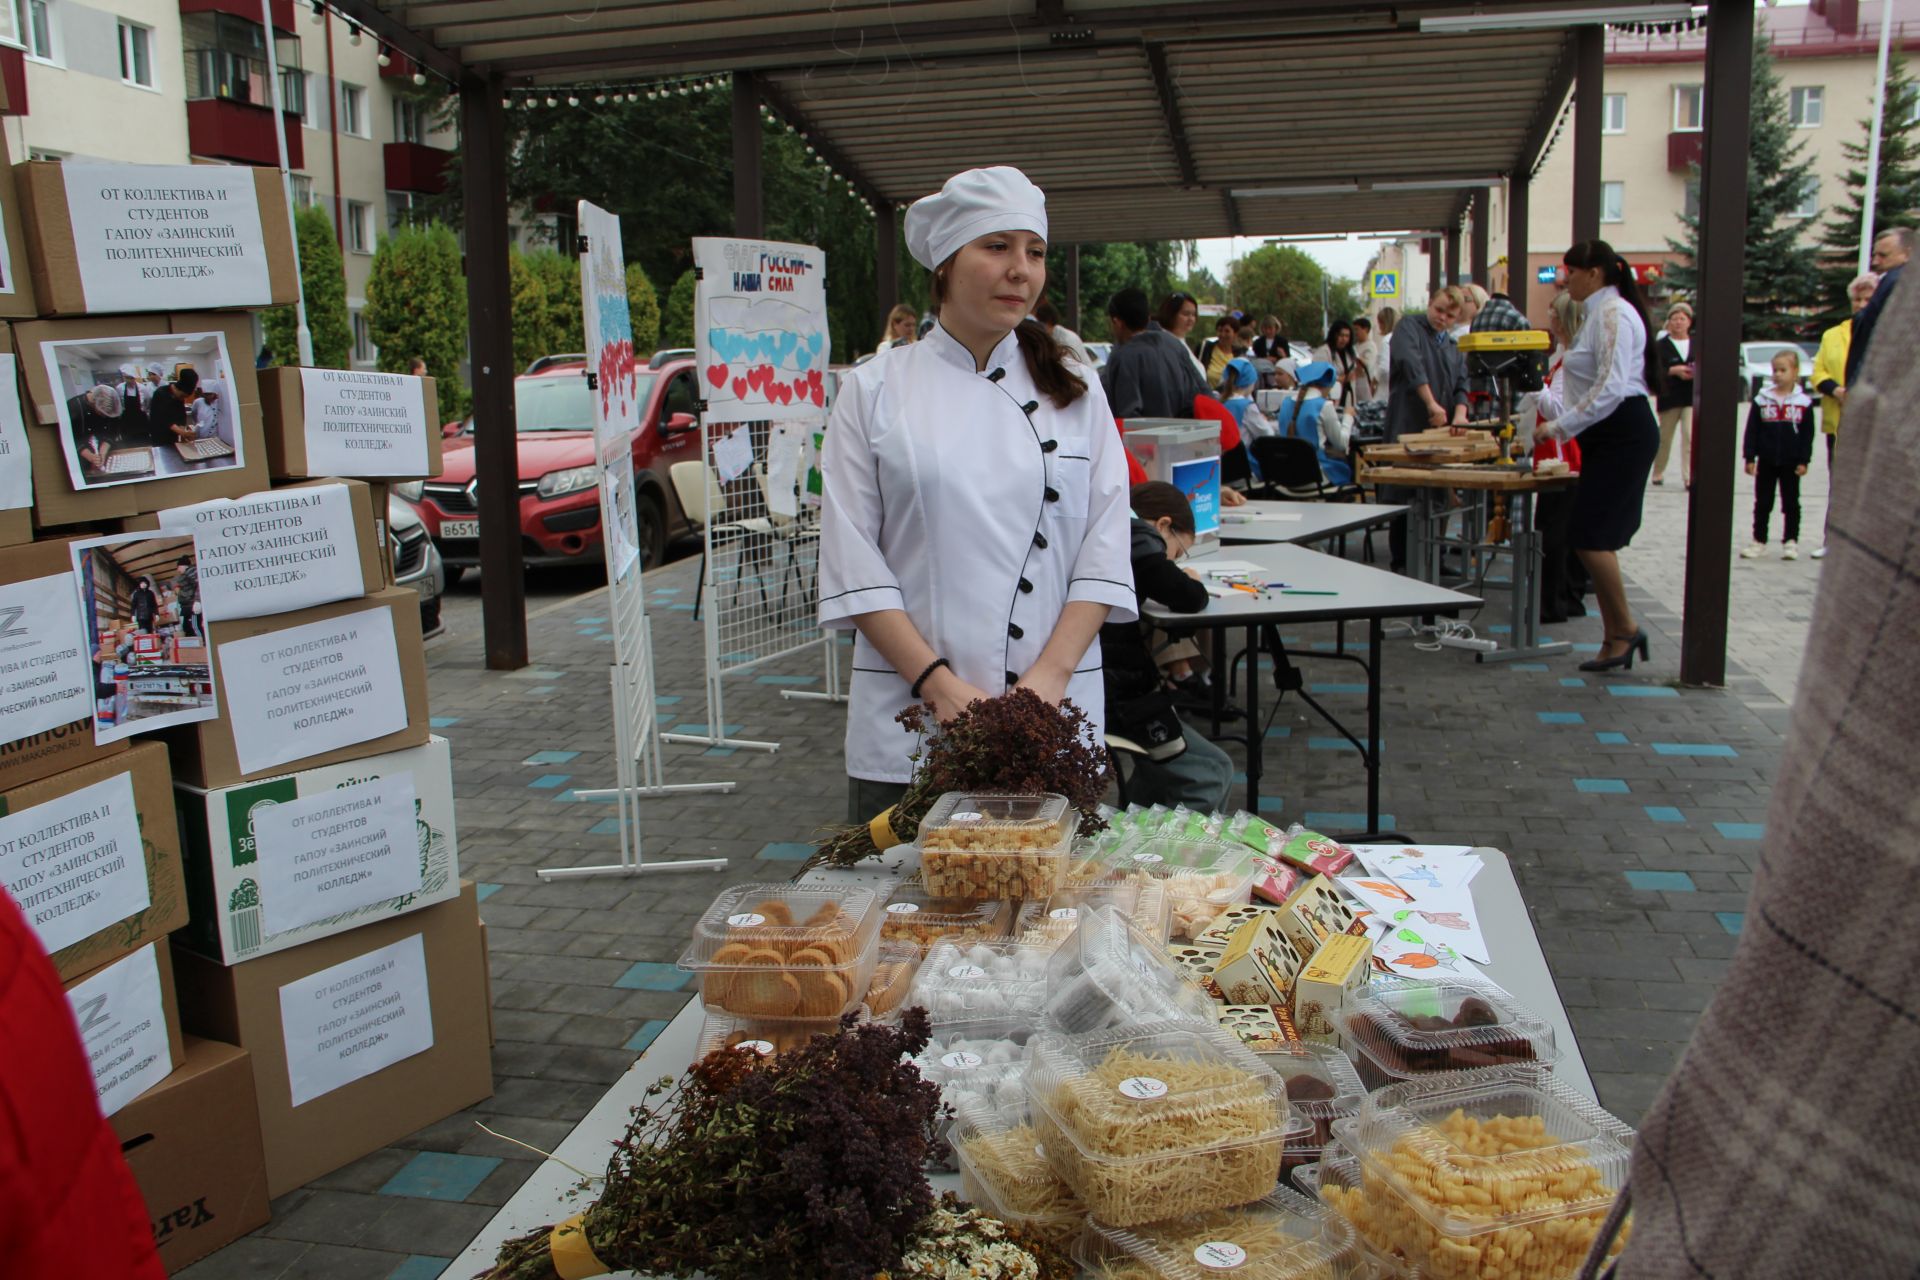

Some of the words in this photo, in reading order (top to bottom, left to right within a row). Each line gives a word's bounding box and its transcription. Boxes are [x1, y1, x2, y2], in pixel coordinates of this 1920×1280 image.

[101, 188, 120, 201] ОТ
[124, 188, 216, 201] КОЛЛЕКТИВА
[217, 189, 228, 201] И
[128, 208, 209, 222] СТУДЕНТОВ
[105, 228, 153, 241] ГАПОУ
[157, 224, 235, 240] «ЗАИНСКИЙ
[106, 243, 244, 260] ПОЛИТЕХНИЧЕСКИЙ
[141, 265, 214, 279] КОЛЛЕДЖ»
[733, 271, 762, 292] НАША
[767, 276, 794, 292] СИЛА
[323, 371, 336, 382] ОТ
[338, 372, 396, 386] КОЛЛЕКТИВА
[396, 376, 404, 386] И
[340, 389, 392, 401] СТУДЕНТОВ
[324, 404, 356, 416] ГАПОУ
[323, 421, 412, 434] ПОЛИТЕХНИЧЕСКИЙ
[196, 510, 215, 524] ОТ
[218, 496, 310, 521] КОЛЛЕКТИВА
[311, 494, 322, 506] И
[222, 516, 303, 538] СТУДЕНТОВ
[198, 542, 248, 560] ГАПОУ
[250, 527, 329, 552] «ЗАИНСКИЙ
[200, 544, 337, 579] ПОЛИТЕХНИЧЕСКИЙ
[234, 569, 308, 592] КОЛЛЕДЖ»
[29, 648, 78, 668] СТУДЕНТОВ
[260, 651, 275, 664] ОТ
[277, 632, 348, 660] КОЛЛЕКТИВА
[349, 630, 359, 641] И
[282, 652, 344, 677] СТУДЕНТОВ
[266, 683, 302, 701] ГАПОУ
[267, 680, 373, 720] ПОЛИТЕХНИЧЕСКИЙ
[291, 815, 306, 828] ОТ
[307, 797, 373, 824] КОЛЛЕКТИВА
[374, 795, 382, 805] И
[18, 808, 101, 849] КОЛЛЕКТИВА
[101, 804, 112, 817] И
[311, 816, 368, 840] СТУДЕНТОВ
[22, 831, 96, 869] СТУДЕНТОВ
[49, 839, 119, 878] «ЗАИНСКИЙ
[294, 847, 328, 865] ГАПОУ
[293, 845, 392, 883] ПОЛИТЕХНИЧЕСКИЙ
[35, 887, 102, 926] КОЛЛЕДЖ»
[314, 987, 328, 1000] ОТ
[329, 963, 387, 995] КОЛЛЕКТИВА
[387, 959, 396, 970] И
[332, 981, 383, 1010] СТУДЕНТОВ
[317, 1014, 348, 1036] ГАПОУ
[317, 1006, 406, 1053] ПОЛИТЕХНИЧЕСКИЙ
